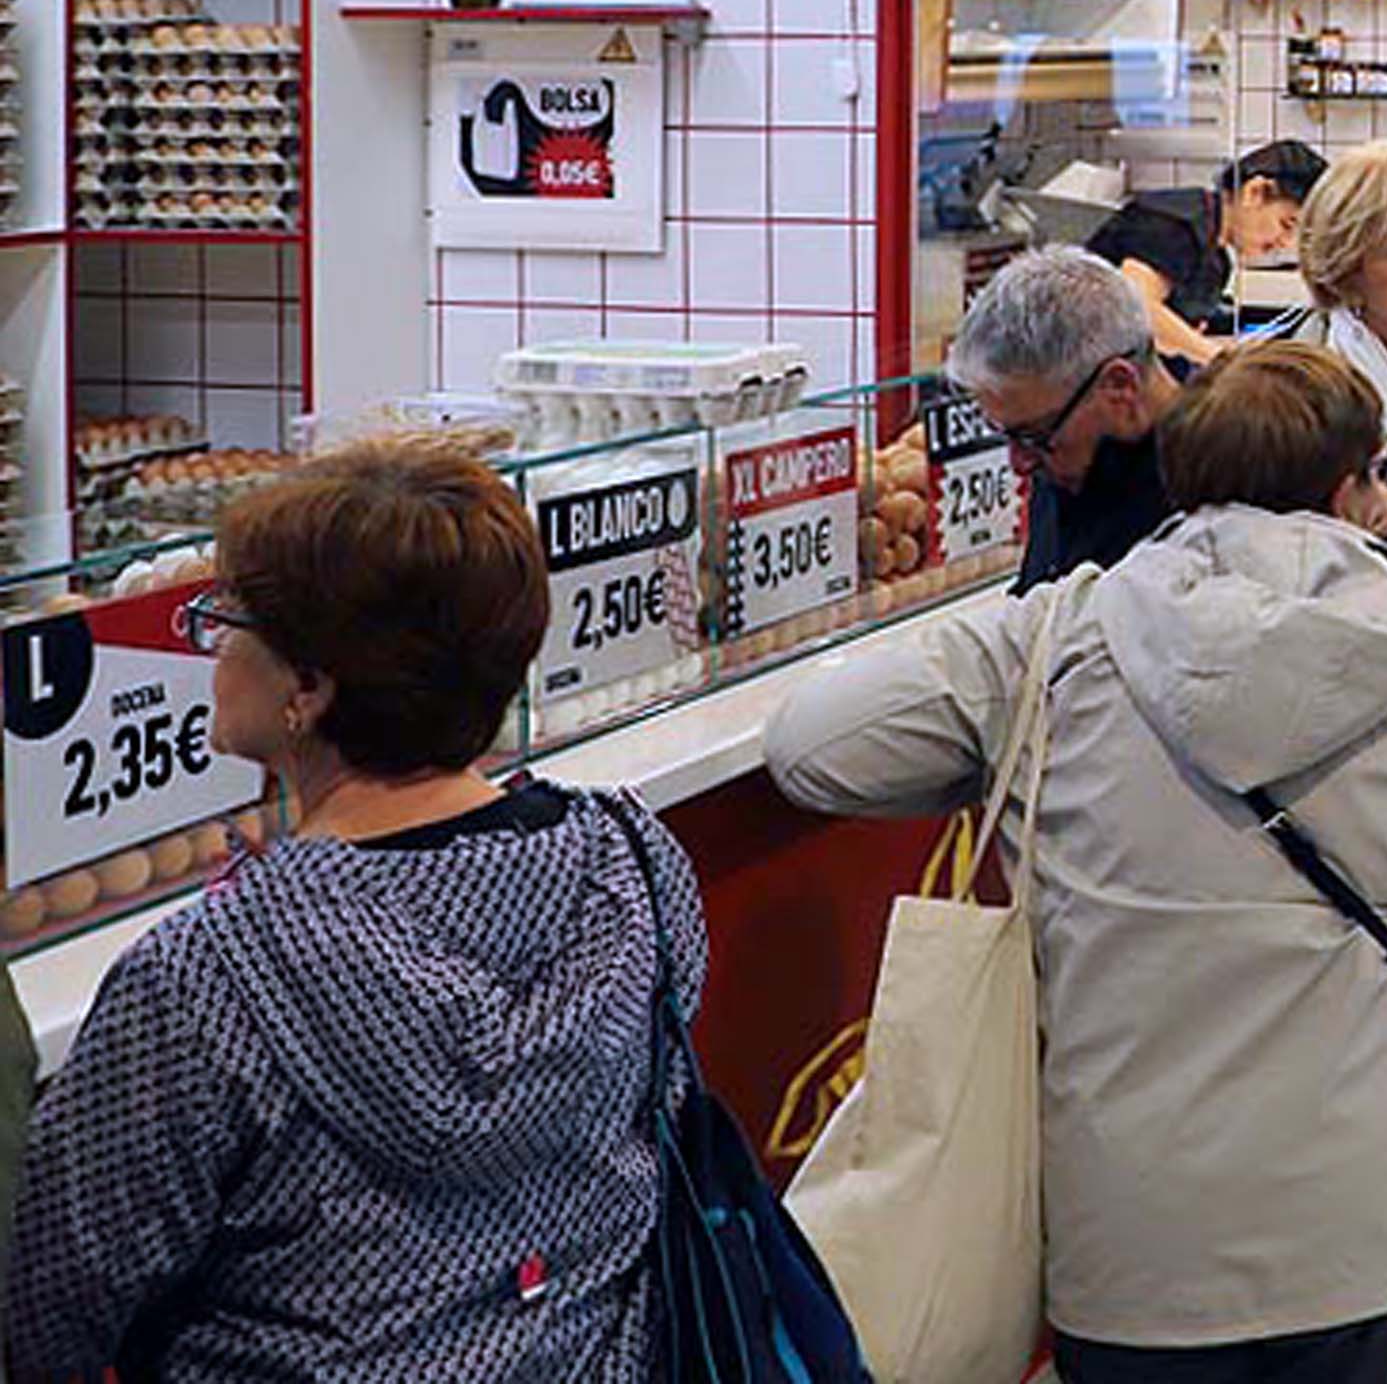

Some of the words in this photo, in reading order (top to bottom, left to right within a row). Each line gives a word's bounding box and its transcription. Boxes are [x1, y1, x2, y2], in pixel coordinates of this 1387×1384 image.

[540, 86, 600, 114] BOLSA
[760, 436, 851, 499] CAMPERO
[947, 464, 1011, 529] 2,50€
[549, 506, 565, 557] L
[569, 484, 665, 553] BLANCO
[753, 514, 833, 590] 3,50€
[571, 568, 667, 651] 2,50€
[28, 633, 56, 703] L
[62, 703, 212, 818] 2,35€
